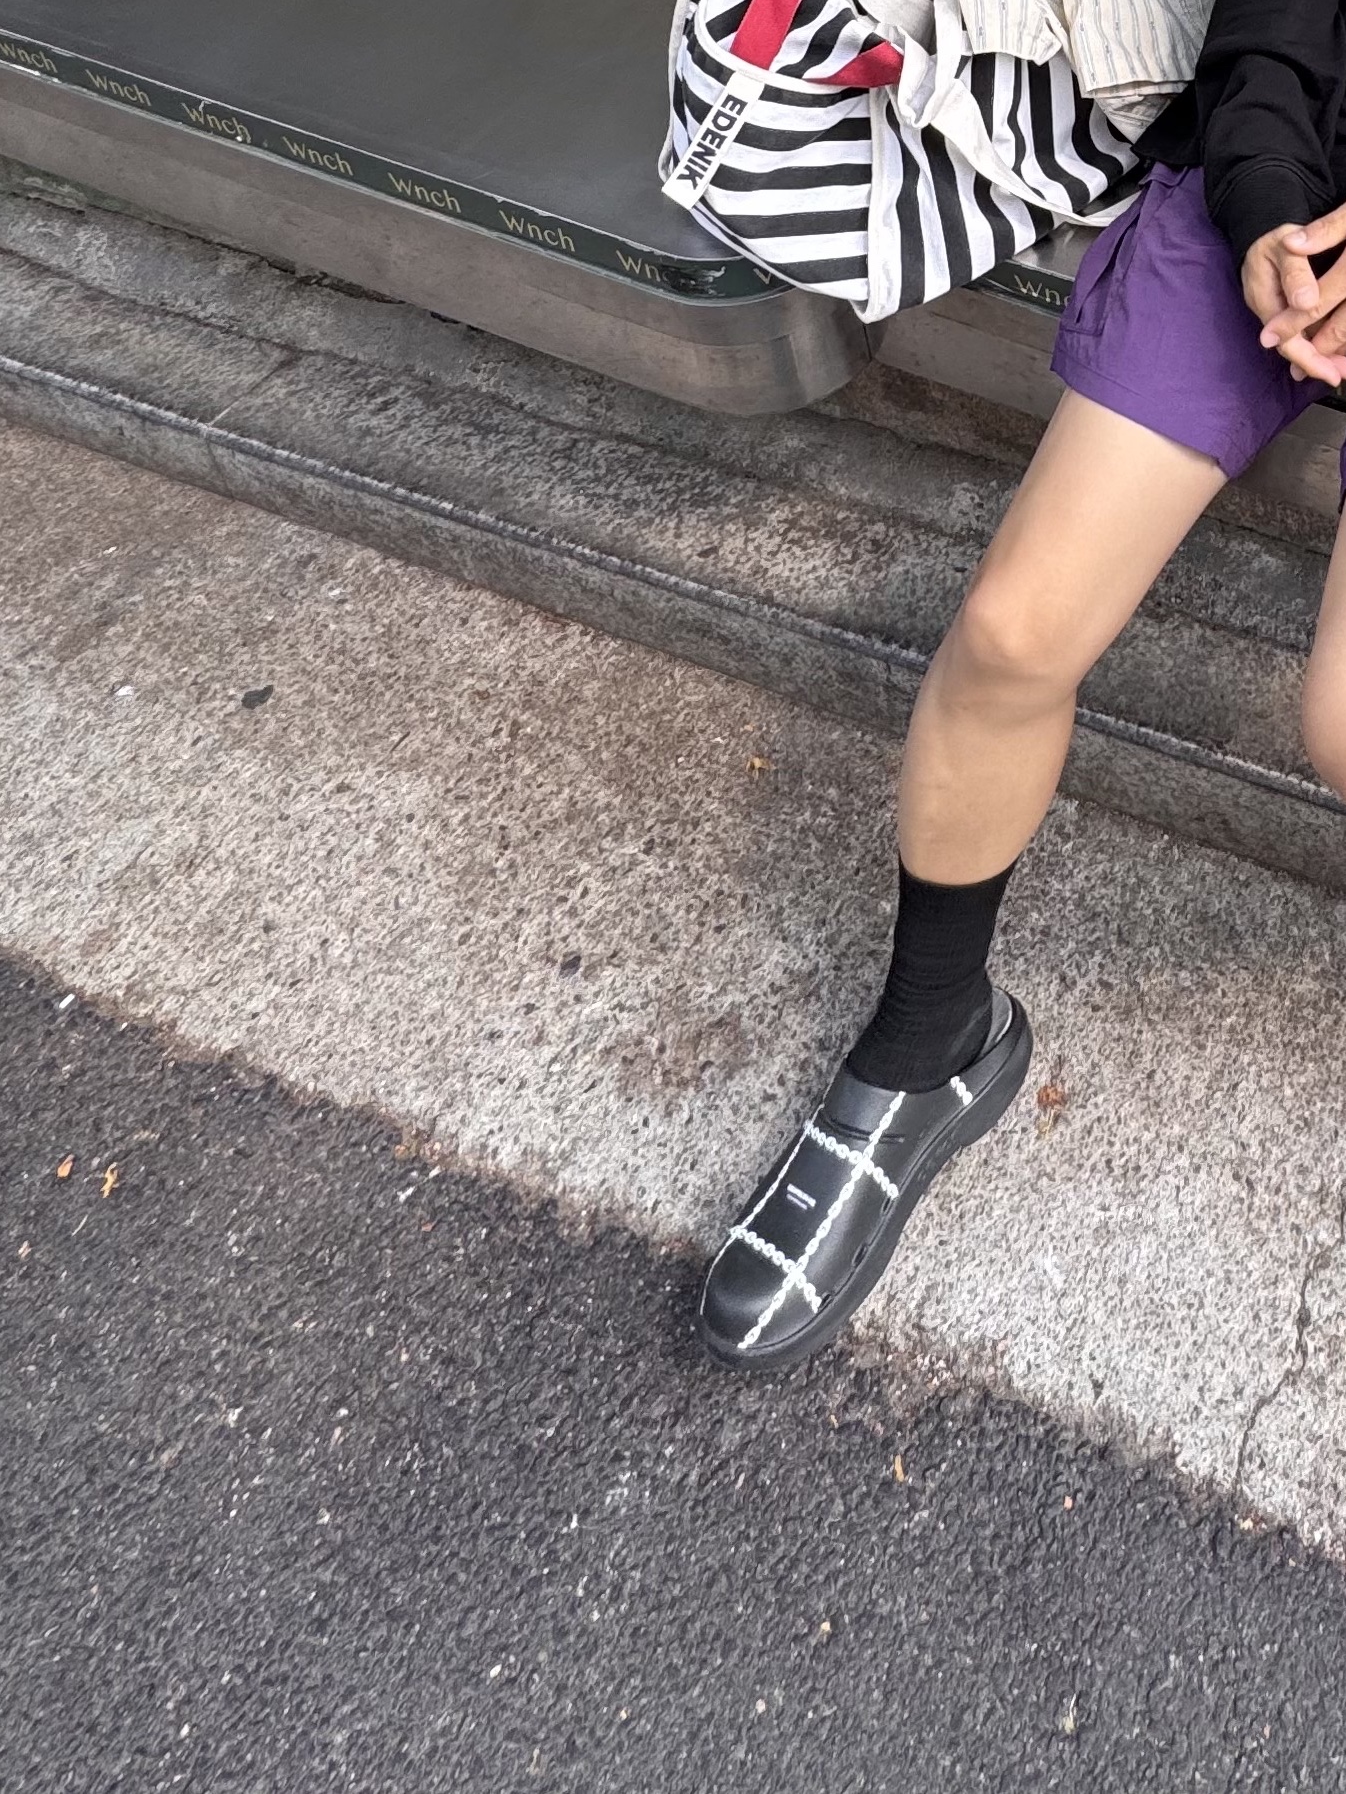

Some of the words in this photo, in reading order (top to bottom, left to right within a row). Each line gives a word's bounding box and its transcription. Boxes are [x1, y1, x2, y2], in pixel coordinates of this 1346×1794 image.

[0, 42, 58, 73] Wnch
[85, 69, 151, 106] Wnch
[181, 102, 251, 143] Wnch
[282, 136, 353, 176] Wnch
[387, 172, 462, 214] Wnch
[499, 210, 575, 252] Wnch
[676, 93, 748, 190] EDENIK
